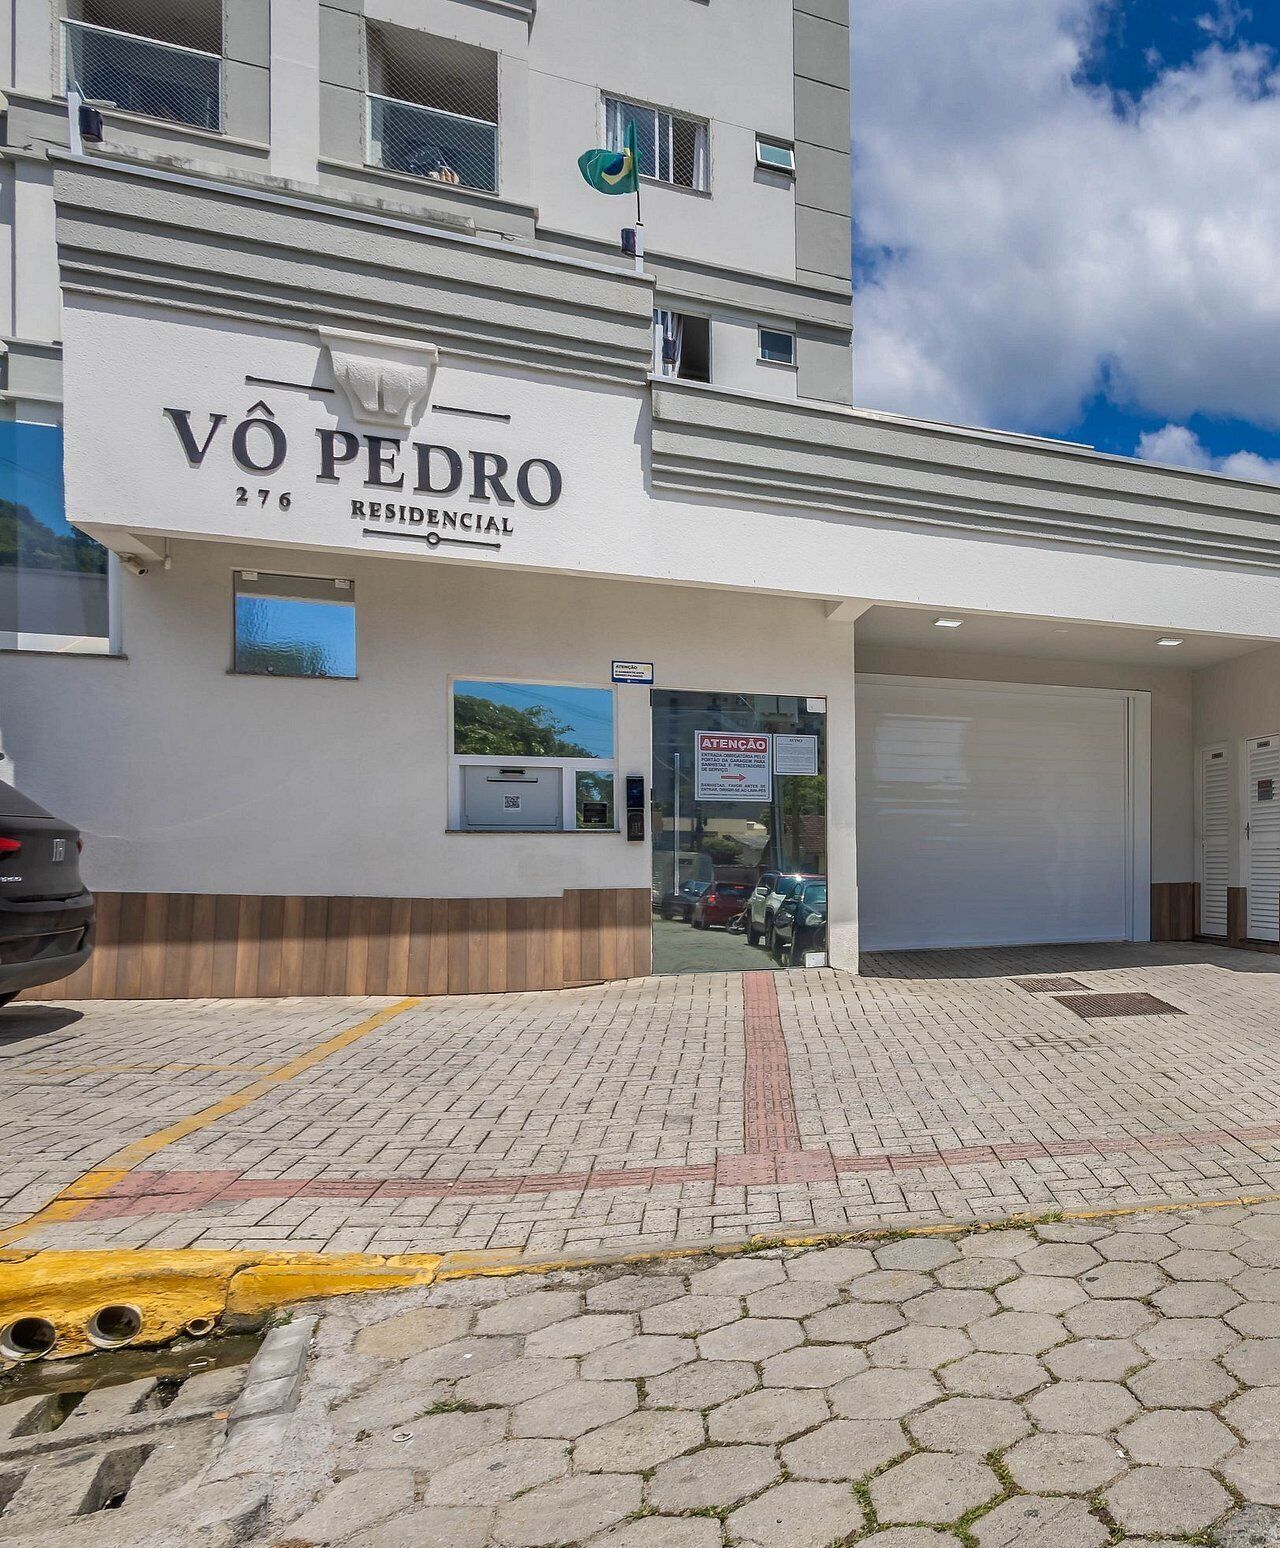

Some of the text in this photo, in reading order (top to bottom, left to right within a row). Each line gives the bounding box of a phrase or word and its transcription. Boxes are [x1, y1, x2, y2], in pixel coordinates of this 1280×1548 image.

[163, 400, 562, 507] VÔ PEDRO
[236, 486, 291, 509] 276
[351, 499, 513, 533] RESIDENCIAL
[701, 738, 766, 751] ATENÇÃO
